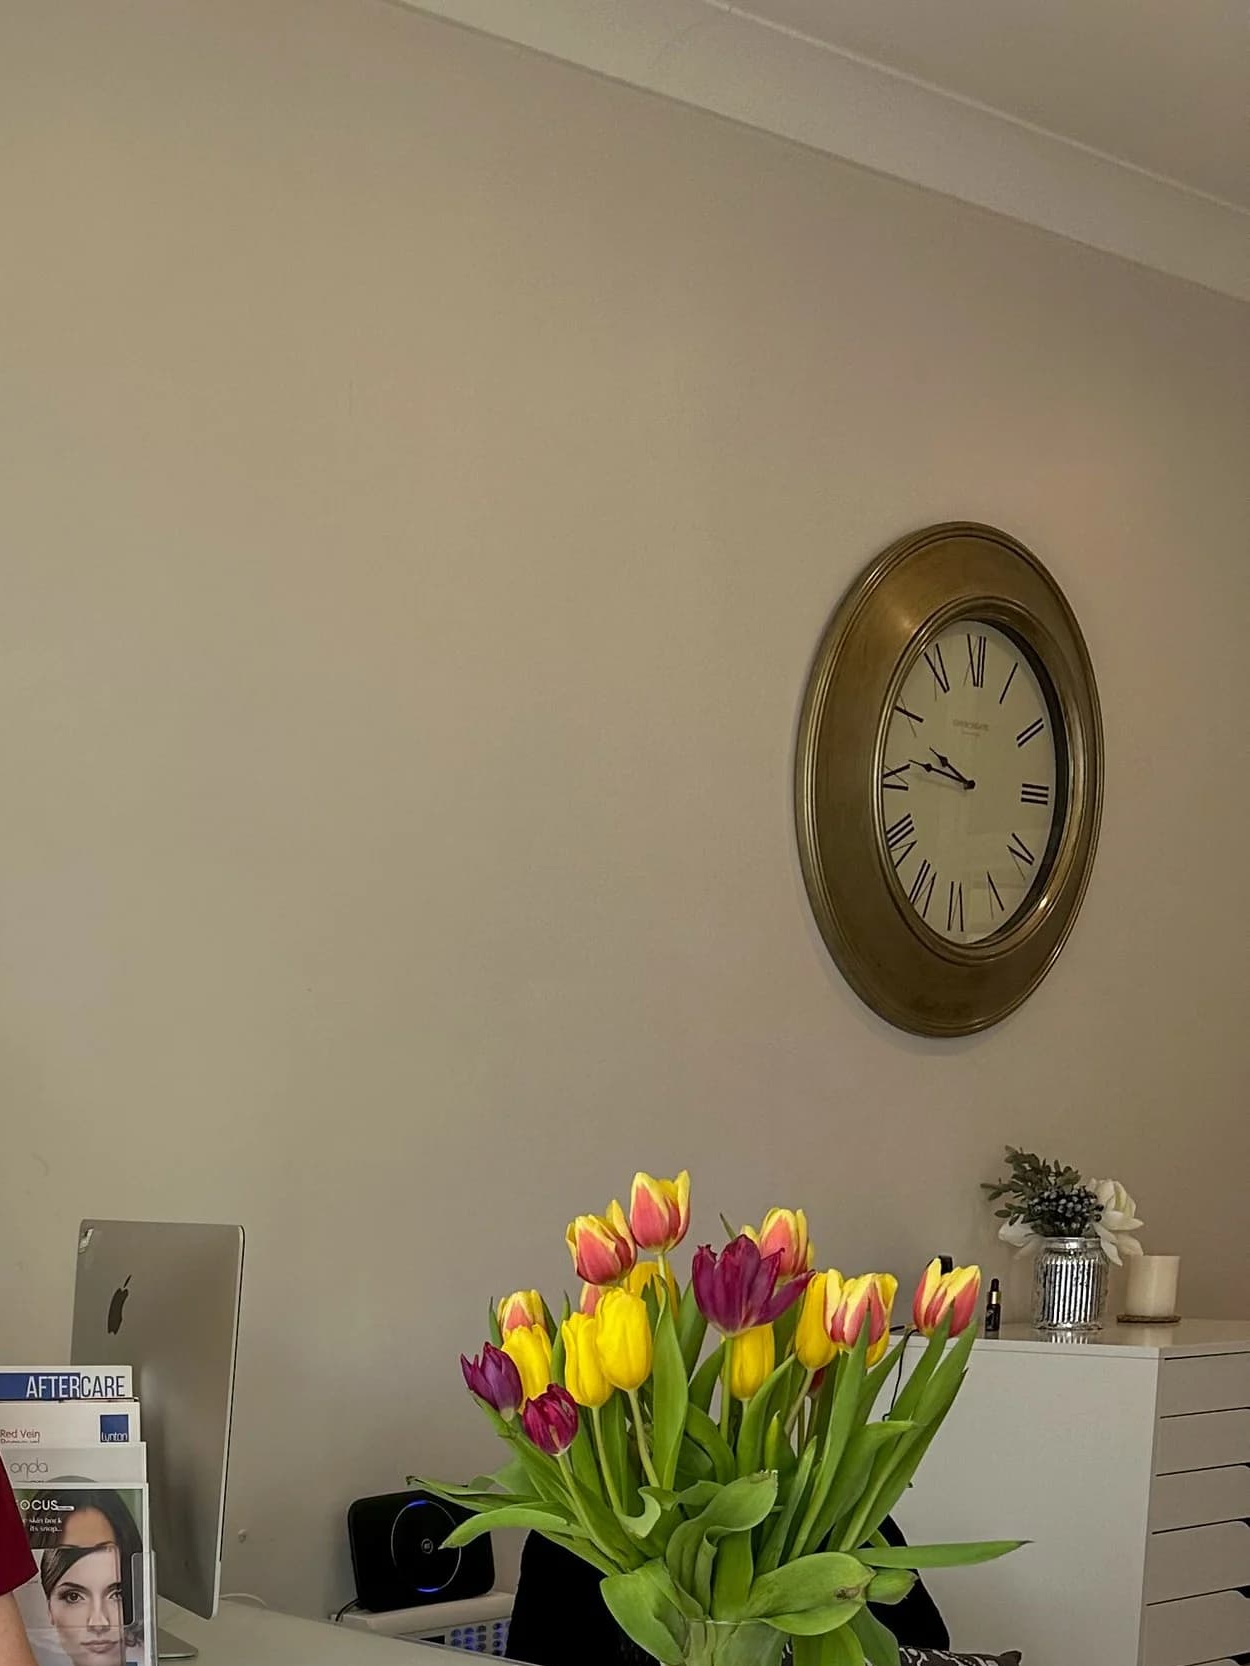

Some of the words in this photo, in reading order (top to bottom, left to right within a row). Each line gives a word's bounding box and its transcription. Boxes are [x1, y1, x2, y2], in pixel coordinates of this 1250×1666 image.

[26, 1375, 126, 1399] AFTERCARE
[0, 1428, 18, 1439] Red
[19, 1429, 41, 1443] Vein
[101, 1430, 128, 1442] Lynton
[19, 1499, 59, 1511] OCUS
